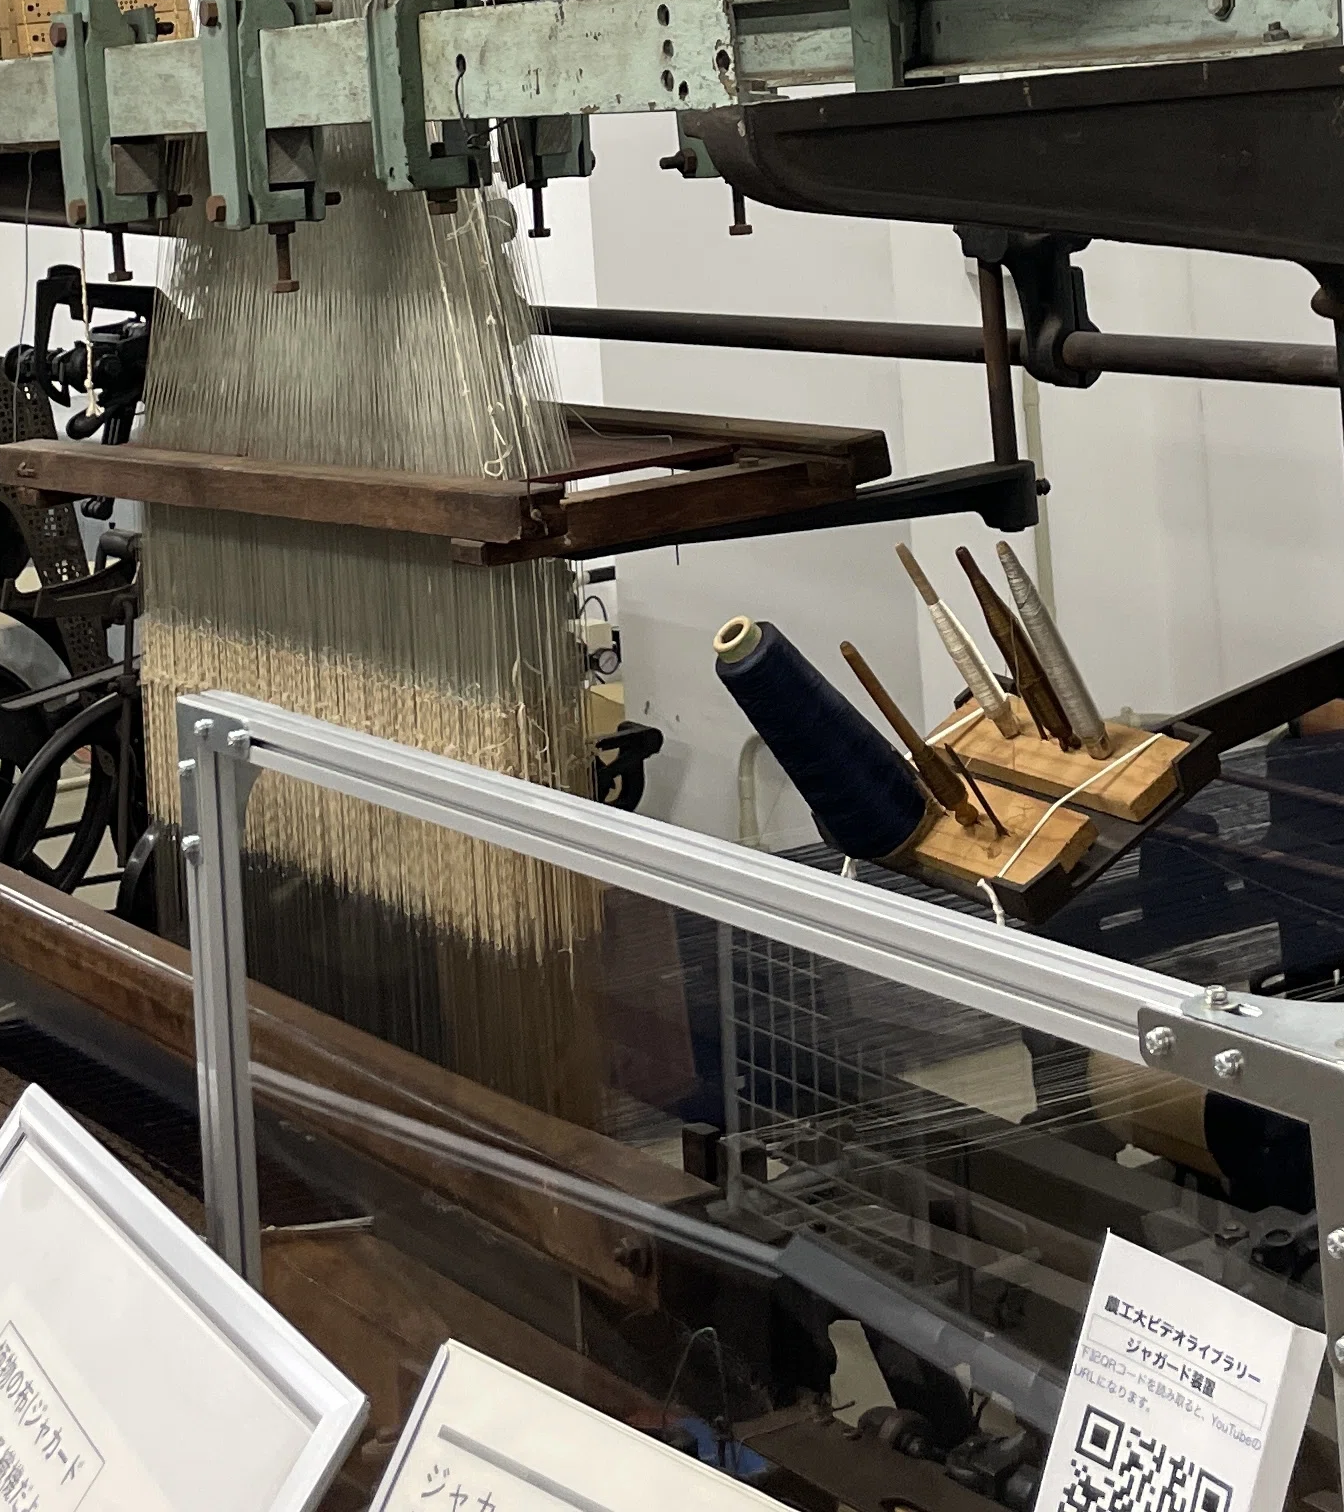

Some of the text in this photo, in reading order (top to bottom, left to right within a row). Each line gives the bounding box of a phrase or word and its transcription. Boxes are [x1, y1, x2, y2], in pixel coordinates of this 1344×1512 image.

[1125, 1337, 1216, 1398] ジャガード装置
